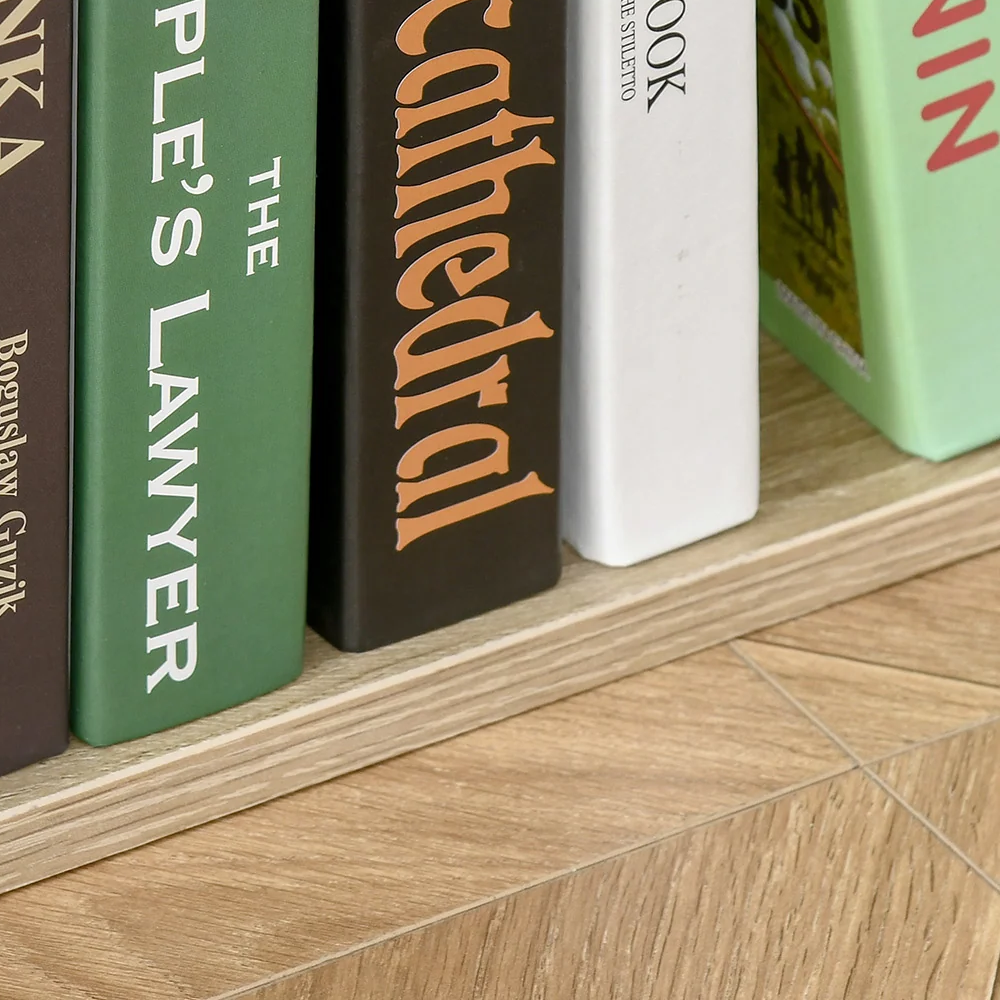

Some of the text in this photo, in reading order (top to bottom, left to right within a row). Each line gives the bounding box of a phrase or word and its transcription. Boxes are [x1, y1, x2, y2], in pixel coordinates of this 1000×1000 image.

[620, 20, 637, 102] STILETTO
[245, 155, 282, 277] THE
[146, 289, 210, 694] LAWYER
